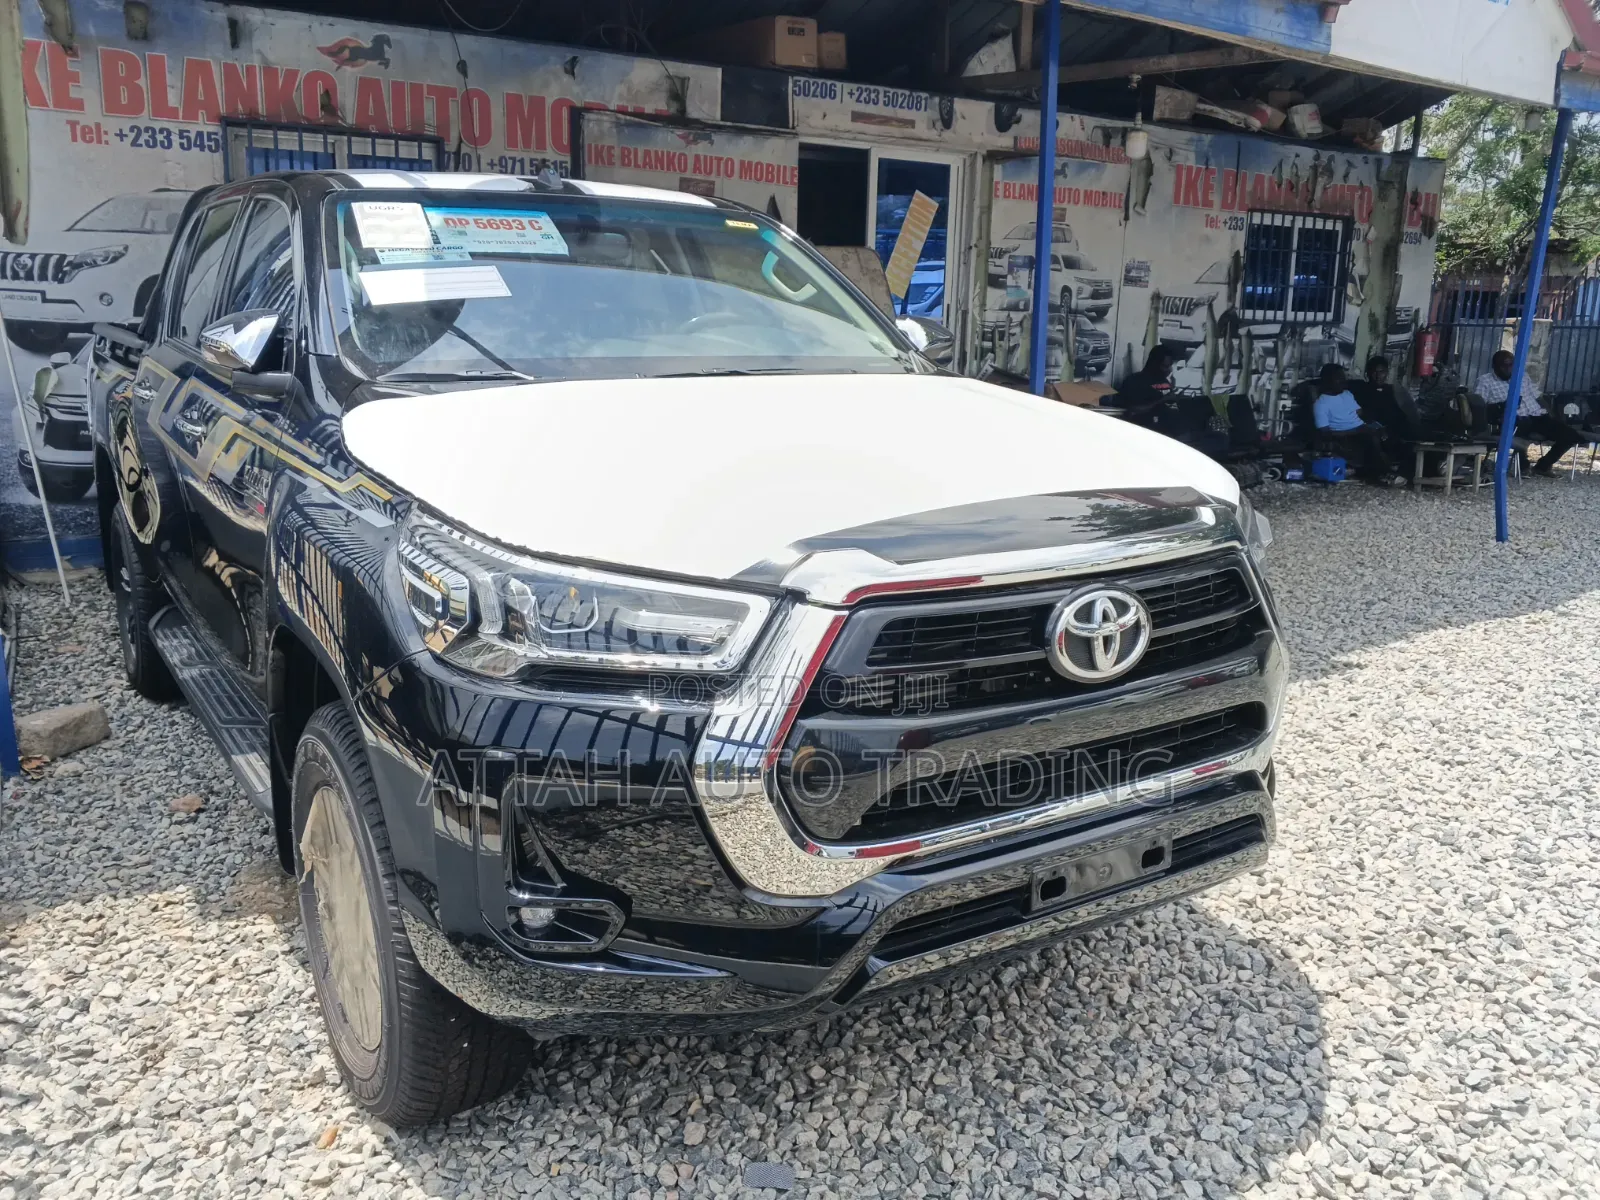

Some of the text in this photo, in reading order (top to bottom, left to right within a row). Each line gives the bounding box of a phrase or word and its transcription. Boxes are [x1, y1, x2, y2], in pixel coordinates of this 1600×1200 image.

[21, 38, 85, 114] KE
[98, 46, 340, 125] BLANKO
[351, 75, 494, 149] AUTO
[793, 79, 929, 112] 50206 +233 502081
[66, 120, 224, 154] Tel: +233 545
[487, 156, 525, 176] +971
[530, 157, 569, 179] 515
[587, 143, 616, 167] IKE
[620, 145, 688, 173] BLANKO
[692, 153, 735, 179] AUTO
[739, 160, 798, 187] MOBILE
[1003, 182, 1039, 202] BLAN
[1083, 190, 1125, 209] MOBILE
[1173, 163, 1217, 209] IKE
[1316, 183, 1373, 225] UTO
[473, 218, 527, 231] 5693
[528, 219, 543, 231] C
[1204, 213, 1245, 232] Tel: +233
[1402, 231, 1422, 245] 2694
